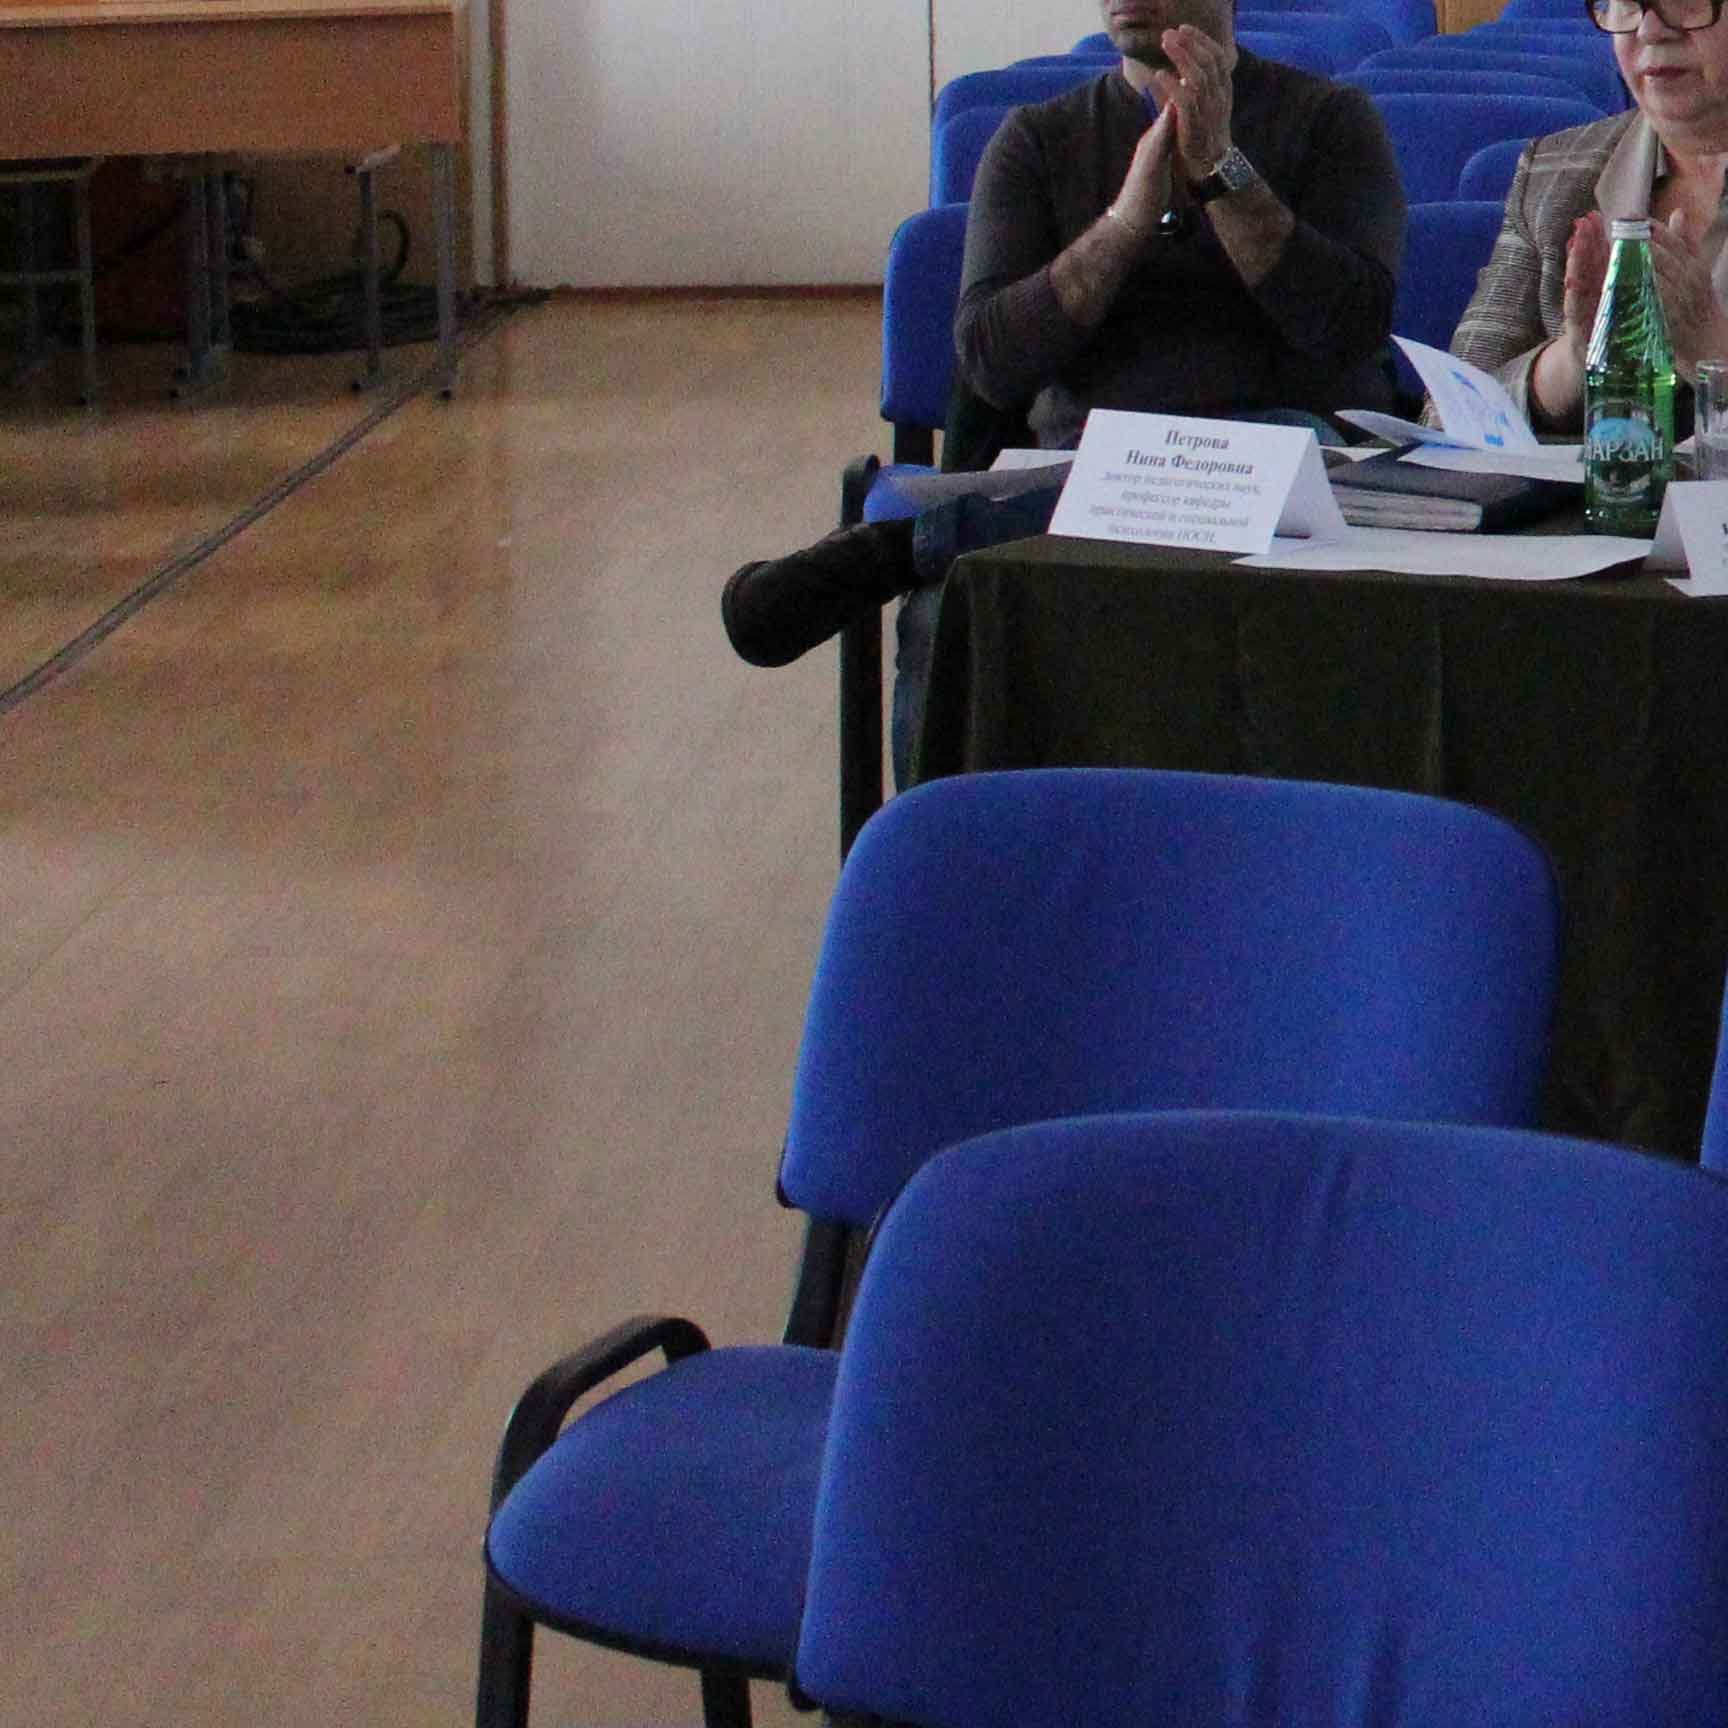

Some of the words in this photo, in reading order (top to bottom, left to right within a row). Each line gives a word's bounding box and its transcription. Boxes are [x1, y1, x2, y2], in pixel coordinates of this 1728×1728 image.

[1165, 429, 1229, 450] Петрова
[1125, 449, 1166, 468] Нина
[1171, 453, 1254, 475] Федоровна
